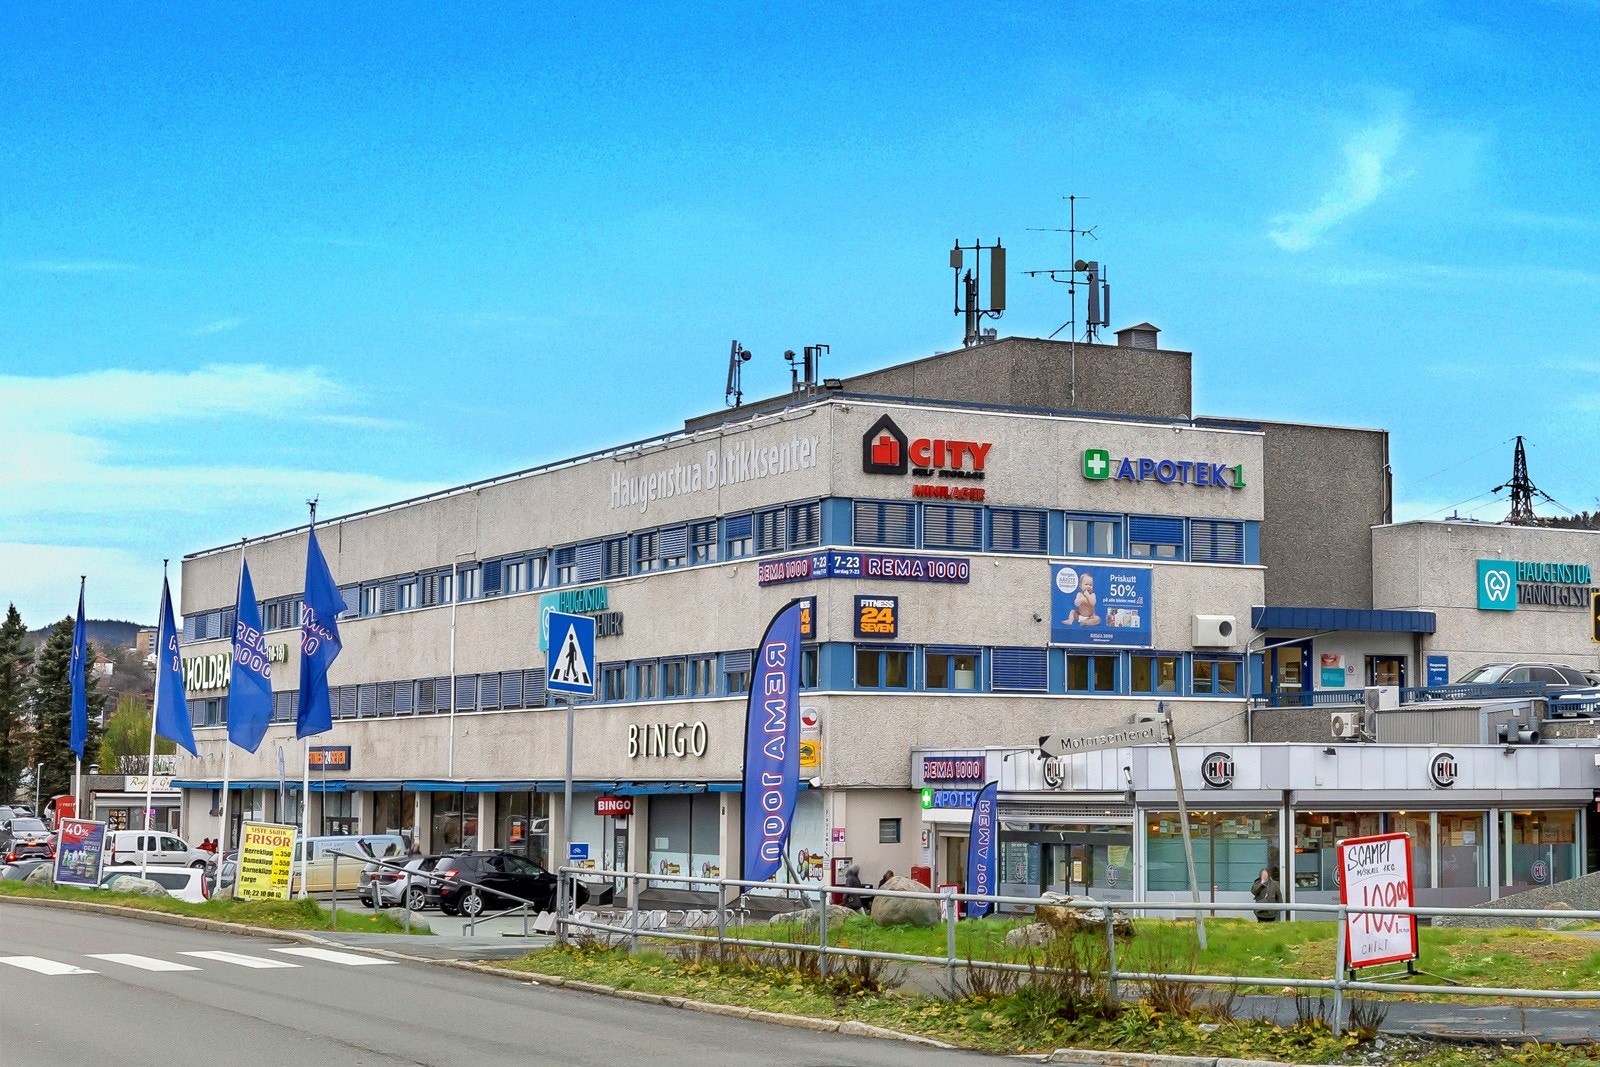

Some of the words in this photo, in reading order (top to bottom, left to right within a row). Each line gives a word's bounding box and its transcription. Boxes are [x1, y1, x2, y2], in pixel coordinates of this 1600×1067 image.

[909, 438, 992, 470] CITY
[610, 461, 702, 514] Haugenstua
[706, 433, 820, 490] Butikksenter
[813, 556, 827, 568] 7-23
[834, 556, 860, 568] 7-23
[868, 558, 924, 577] REMA
[928, 560, 968, 579] 1000
[759, 564, 784, 582] REMA
[786, 560, 808, 578] 1000
[1110, 574, 1136, 583] Priskutt
[1517, 562, 1592, 584] HAUGENSTUA
[1110, 584, 1136, 597] 50%
[560, 586, 608, 613] HAUGENSTUA
[860, 600, 894, 608] FITNESS
[861, 608, 894, 624] 24
[860, 624, 894, 633] SEVEN
[628, 721, 707, 758] BINGO
[1061, 728, 1155, 749] Motorsenteret
[924, 762, 953, 779] REMA
[956, 762, 980, 778] 1000
[598, 801, 631, 811] BINGO
[934, 791, 979, 808] APOTEK
[245, 834, 291, 847] FRISØR
[245, 848, 273, 856] Herreklipp
[1348, 841, 1391, 871] SCAMPI
[244, 857, 273, 866] Dameklipp
[242, 866, 272, 875] Barneklipp
